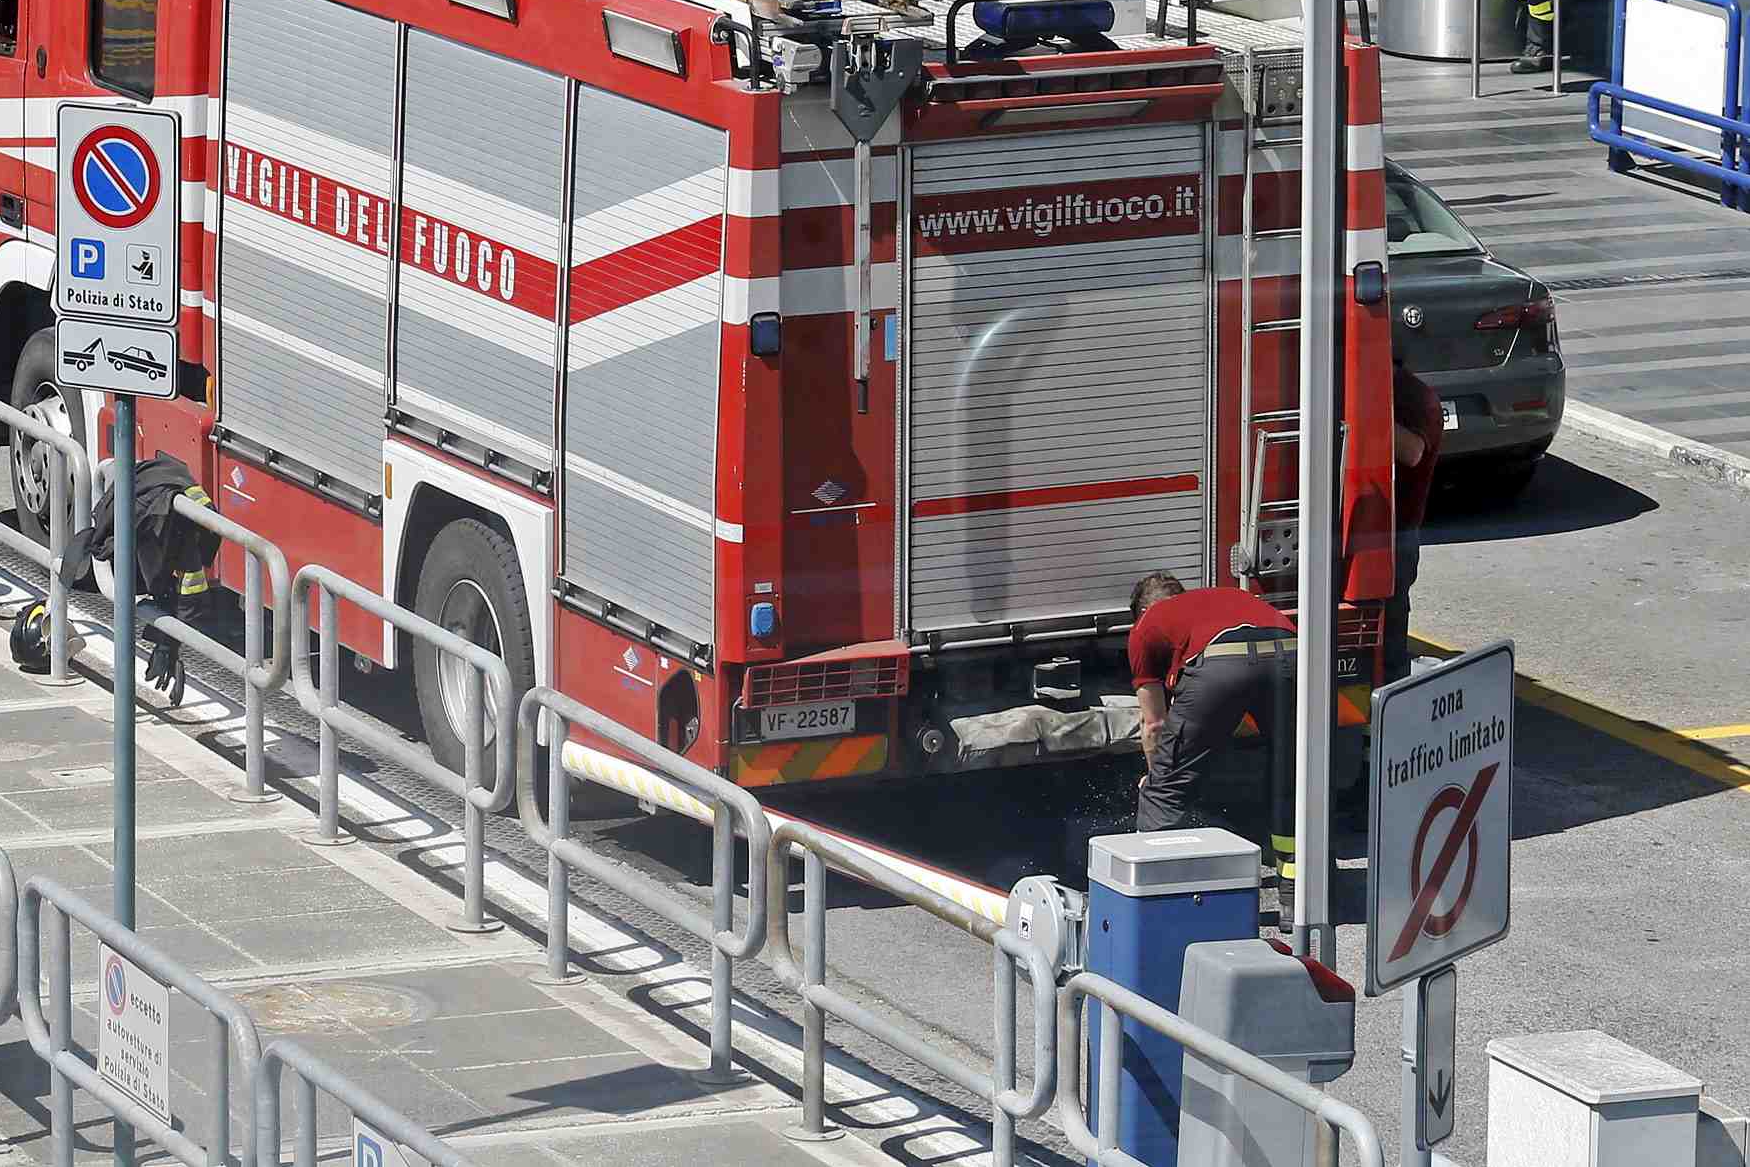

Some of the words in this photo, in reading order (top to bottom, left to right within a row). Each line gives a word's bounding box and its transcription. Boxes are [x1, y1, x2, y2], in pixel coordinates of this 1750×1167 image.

[225, 144, 319, 227] VIGILI
[335, 185, 389, 254] DEL
[413, 215, 516, 302] FUOCO
[918, 185, 1195, 238] www.vigilfuoco.it
[78, 243, 98, 274] P
[67, 287, 109, 306] Polizia
[112, 292, 124, 308] di
[128, 294, 163, 313] Stato
[767, 713, 787, 732] VF
[797, 706, 850, 730] 22587
[1431, 688, 1463, 722] zona
[1387, 742, 1444, 789] traffico
[1449, 715, 1505, 763] limitato
[129, 992, 162, 1025] eccetto
[106, 1017, 152, 1061] autovetture
[153, 1047, 162, 1067] di
[120, 1048, 150, 1079] servizio
[104, 1055, 131, 1085] Polizia
[133, 1077, 141, 1094] di
[142, 1082, 166, 1112] Stato
